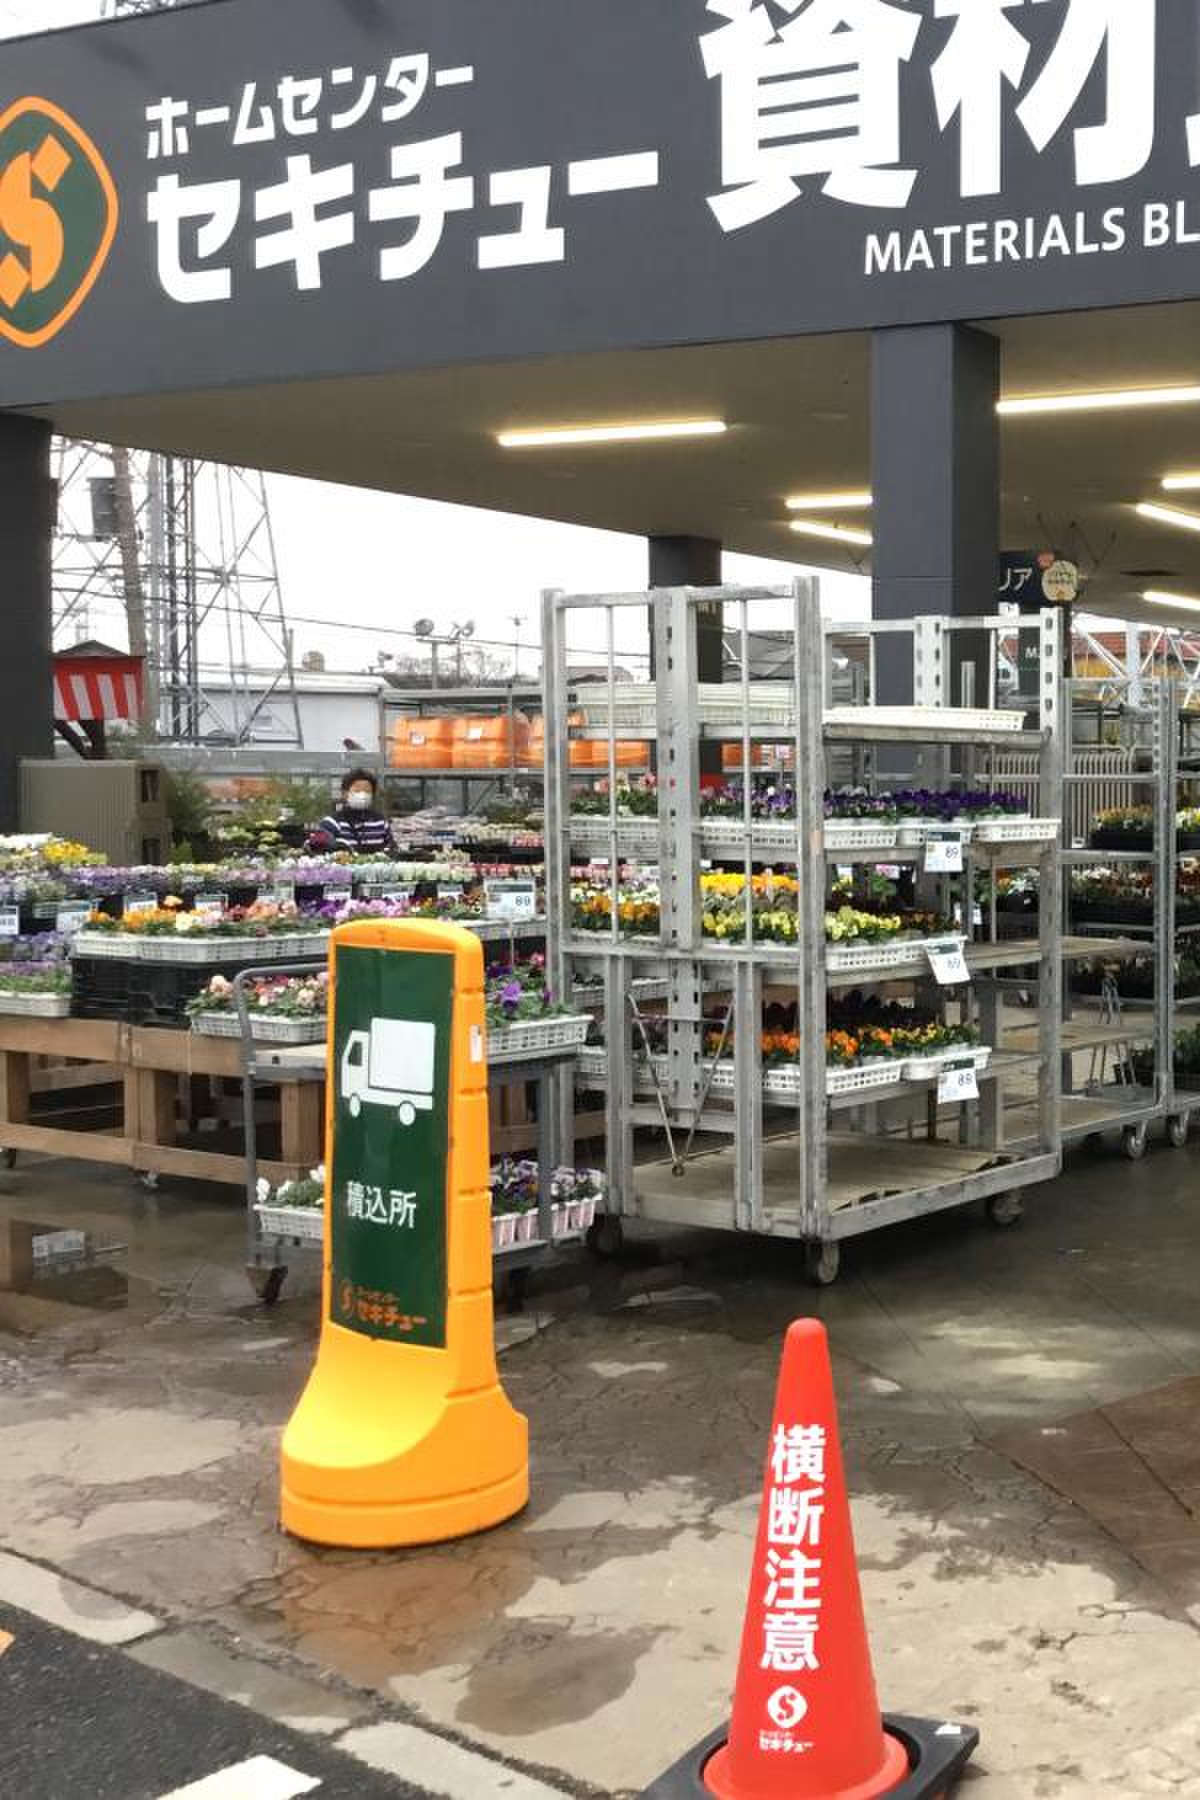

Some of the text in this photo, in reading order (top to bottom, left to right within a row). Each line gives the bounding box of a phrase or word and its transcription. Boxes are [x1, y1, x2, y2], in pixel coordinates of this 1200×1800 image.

[146, 53, 473, 158] ホームセンター
[147, 131, 658, 303] セキチュー
[864, 206, 1125, 274] MATERIALS
[347, 1180, 417, 1229] 積込所
[758, 1424, 827, 1671] 横断注意
